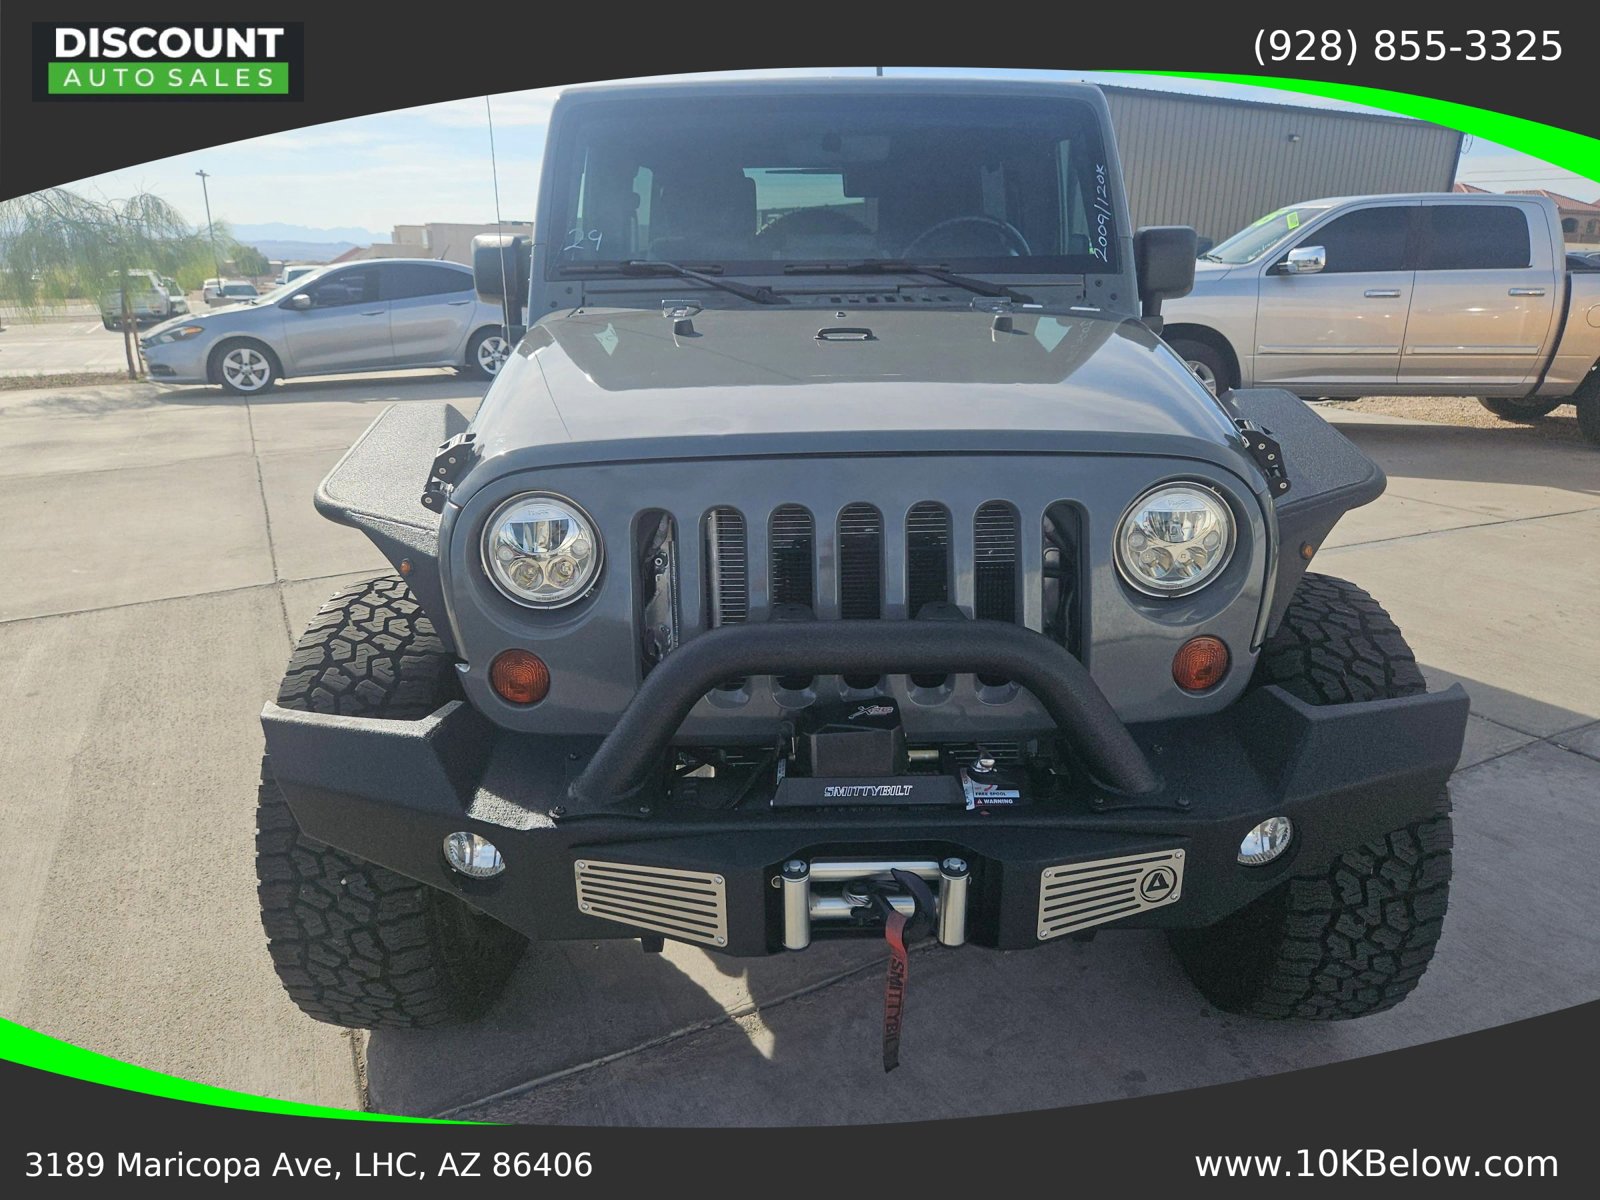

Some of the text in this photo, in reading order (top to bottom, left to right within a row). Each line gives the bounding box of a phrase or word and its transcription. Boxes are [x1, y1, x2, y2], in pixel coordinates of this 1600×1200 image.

[563, 228, 603, 252] 29
[824, 785, 913, 797] SMITTYBILT
[885, 957, 905, 1050] SMITTYBIL
